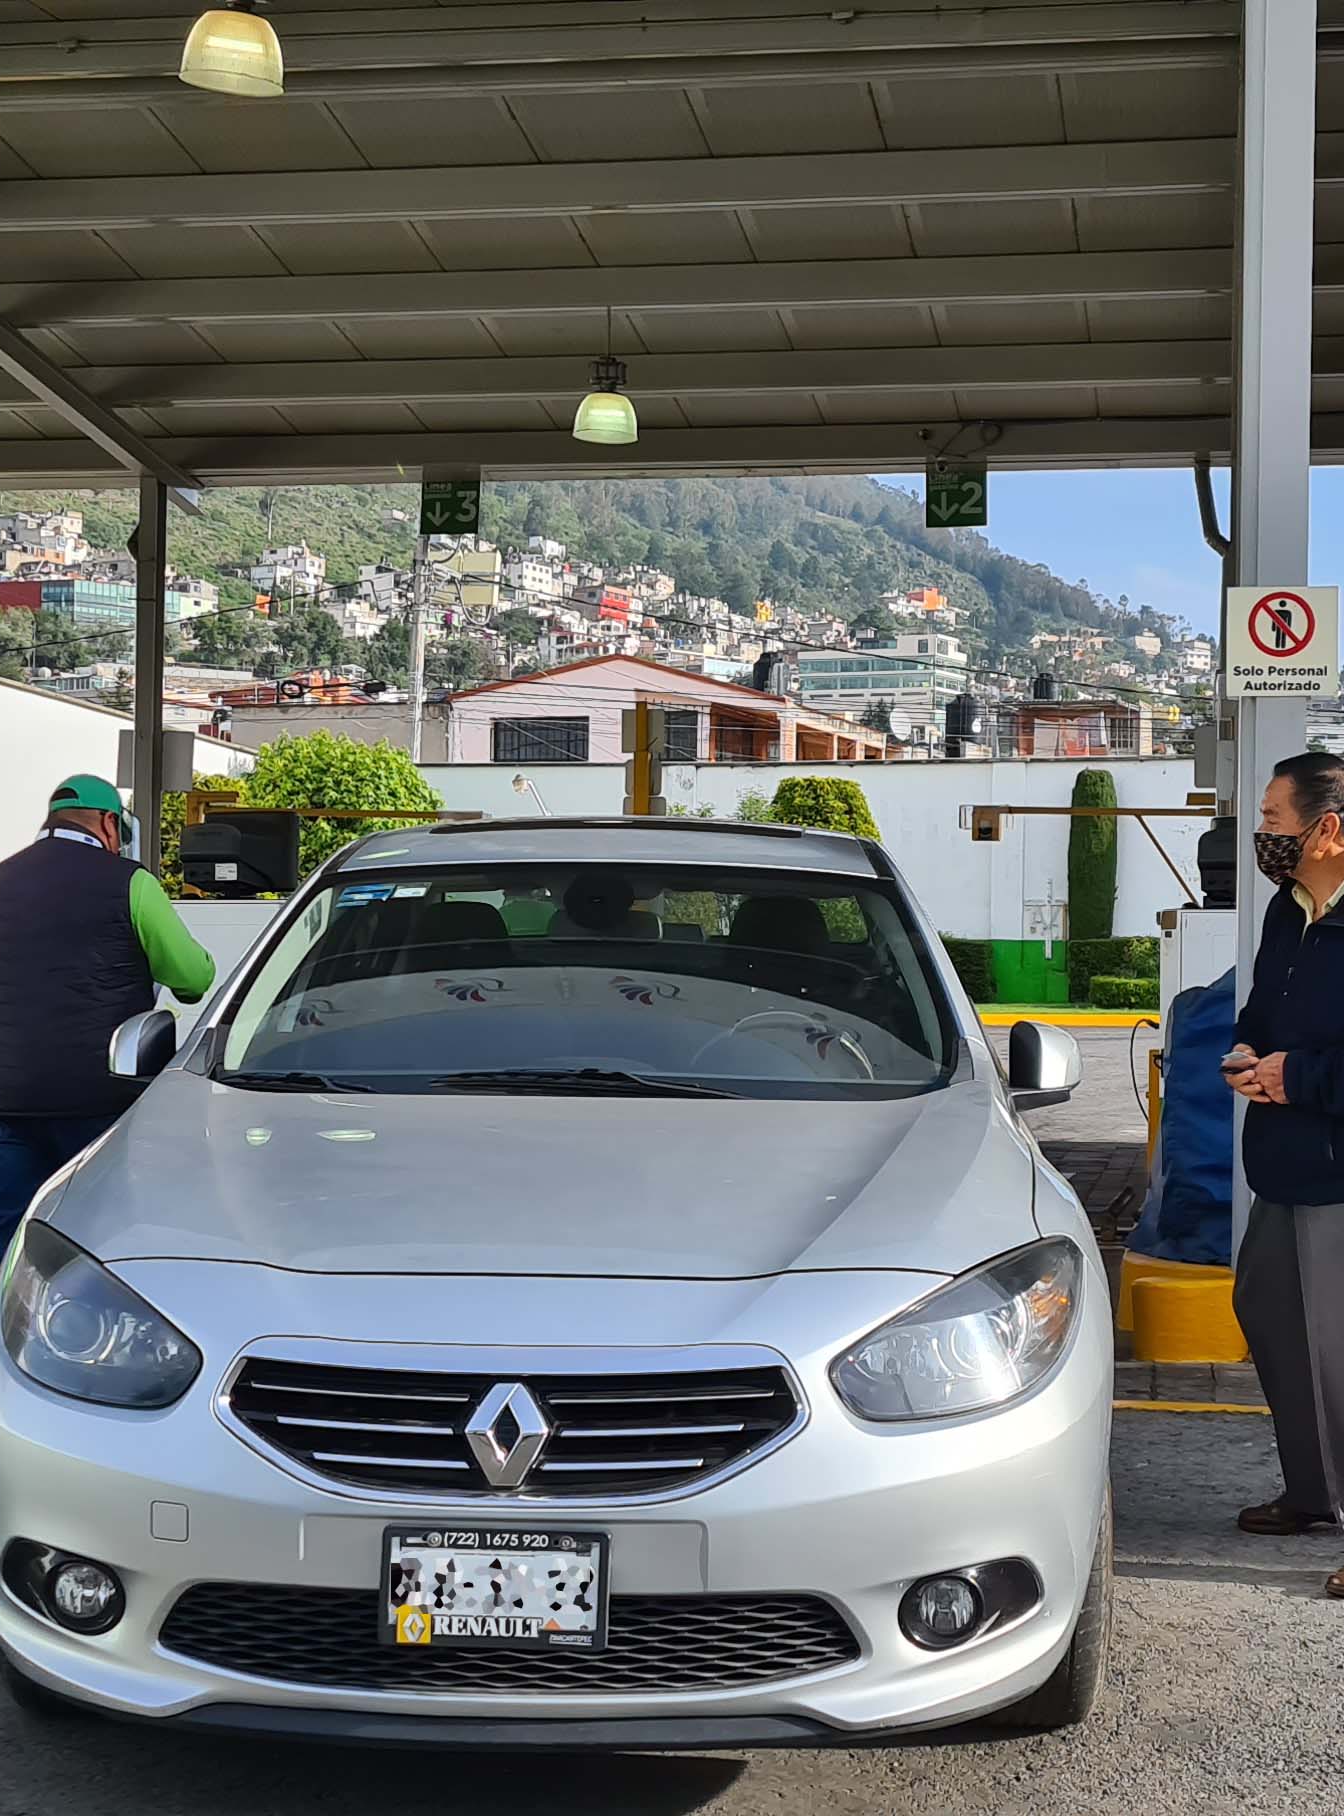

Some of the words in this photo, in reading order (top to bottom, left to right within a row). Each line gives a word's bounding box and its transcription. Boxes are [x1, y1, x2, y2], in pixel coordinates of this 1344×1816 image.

[455, 490, 478, 523] 3
[959, 481, 984, 514] 2
[1233, 666, 1264, 677] Solo
[1268, 665, 1328, 677] Personal
[1243, 680, 1321, 691] Autorizado
[443, 1532, 480, 1548] (722)
[484, 1533, 519, 1547] 1675
[522, 1534, 549, 1548] 920
[432, 1615, 544, 1638] RENAULT
